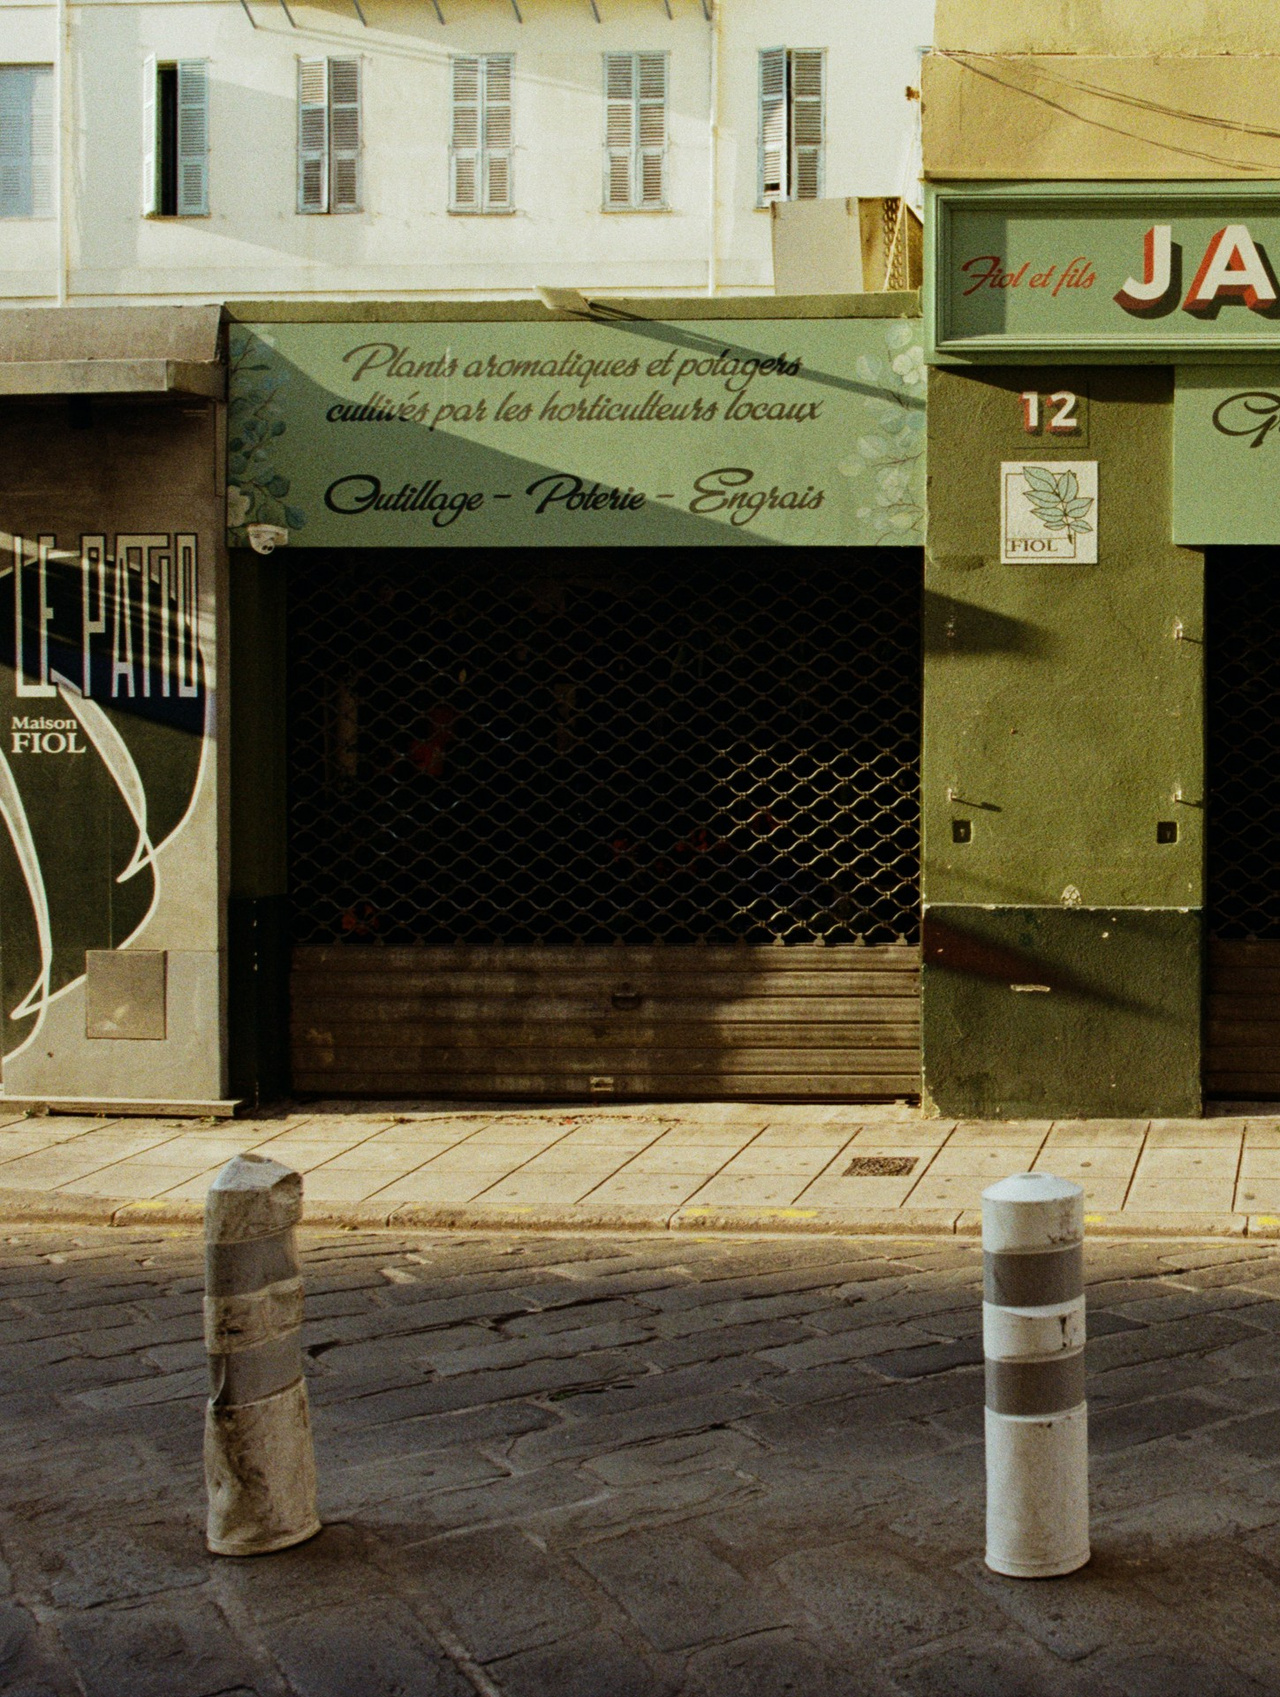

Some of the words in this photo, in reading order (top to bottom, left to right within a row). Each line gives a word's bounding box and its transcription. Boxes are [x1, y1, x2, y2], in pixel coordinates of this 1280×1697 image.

[961, 256, 1031, 297] Fiol
[1029, 264, 1058, 289] et
[1051, 256, 1097, 297] fils
[342, 342, 459, 382] Plants
[462, 350, 641, 388] aromatiques
[646, 348, 679, 377] et
[672, 348, 803, 392] potagers
[325, 390, 430, 423] cultivés
[428, 398, 488, 431] par
[493, 390, 534, 422] les
[538, 389, 719, 422] horticulteurs
[724, 389, 824, 423] locaux
[1019, 391, 1082, 437] 12
[324, 474, 484, 528] Outillage
[526, 473, 647, 515] Poterie
[689, 467, 827, 527] Engrais
[1010, 539, 1059, 553] FIOL
[14, 535, 57, 698] LE
[81, 533, 199, 698] PATIO
[11, 716, 78, 731] Maison
[11, 732, 87, 754] FIOL
